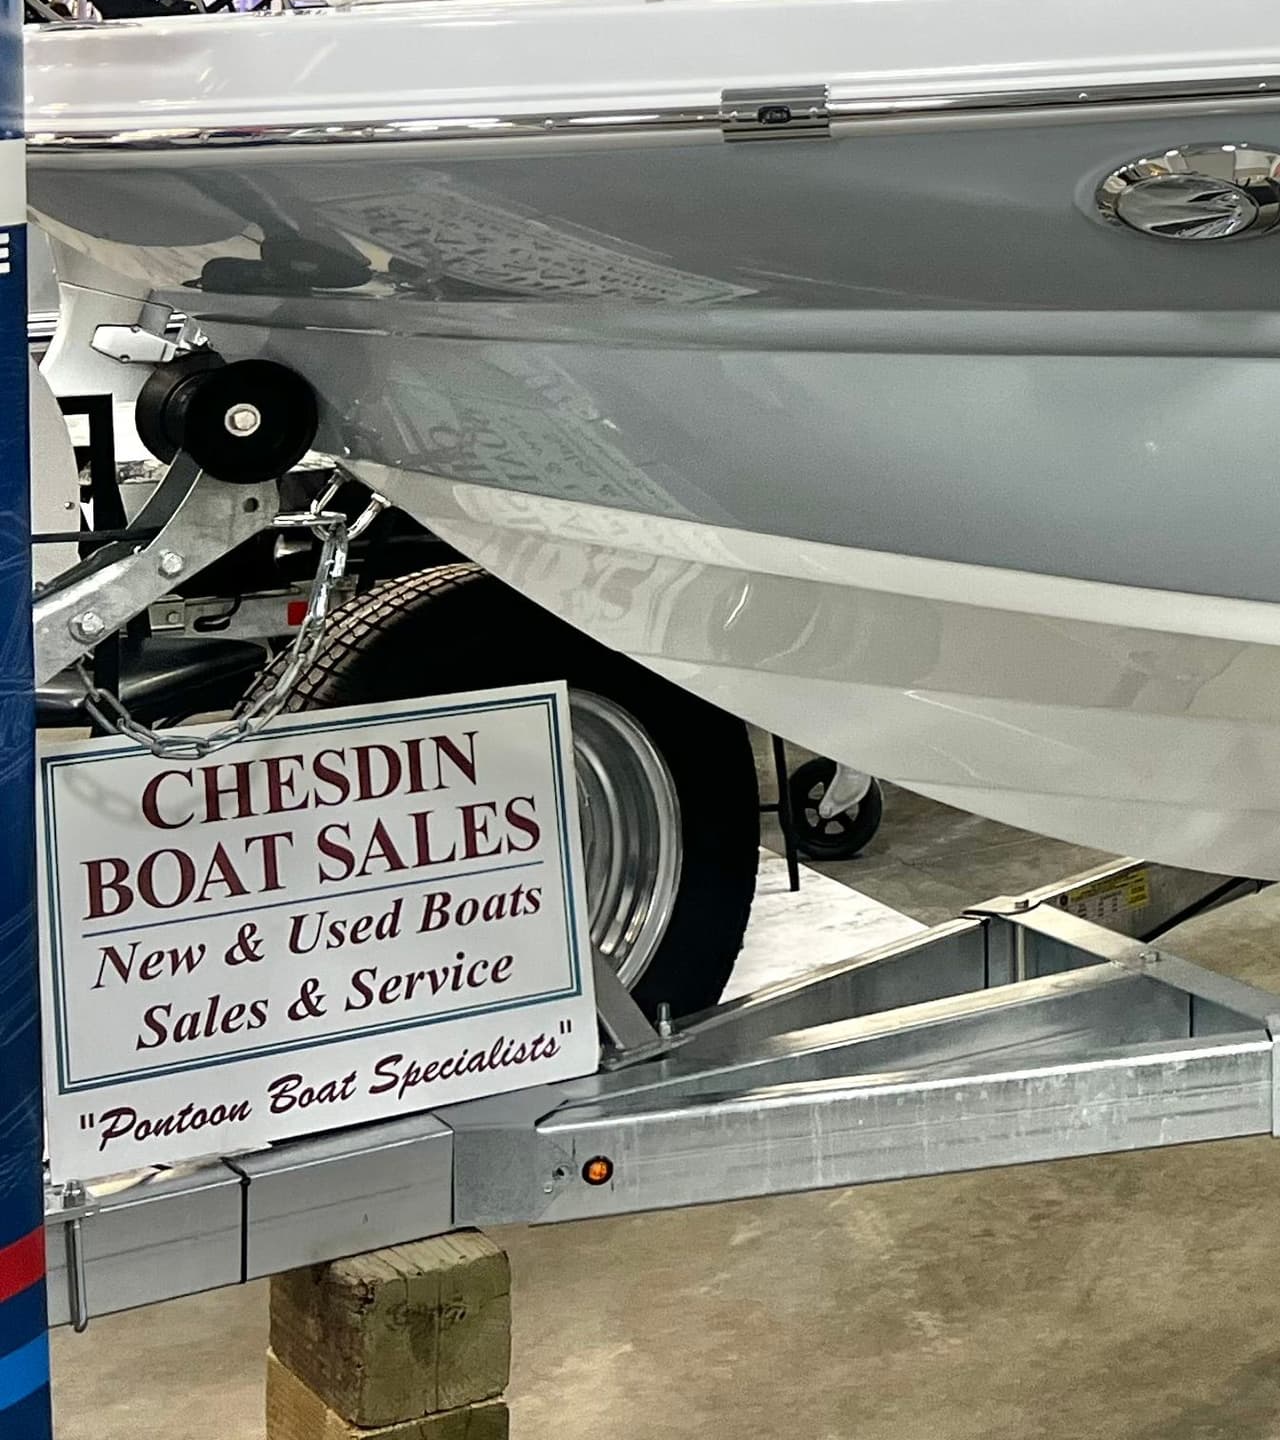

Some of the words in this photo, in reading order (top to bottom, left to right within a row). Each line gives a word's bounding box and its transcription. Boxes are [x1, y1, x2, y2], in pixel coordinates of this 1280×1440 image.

[142, 731, 479, 830] CHESDIN
[81, 831, 294, 921] BOAT
[317, 796, 541, 883] SALES
[92, 941, 207, 989] New
[224, 922, 265, 966] &
[288, 898, 403, 956] Used
[416, 882, 543, 934] Boats
[136, 996, 269, 1050] Sales
[287, 978, 328, 1020] &
[344, 951, 514, 1011] Service
[80, 1098, 252, 1151] "Pontoon
[267, 1072, 357, 1114] Boat
[369, 1019, 572, 1100] Specialists"
